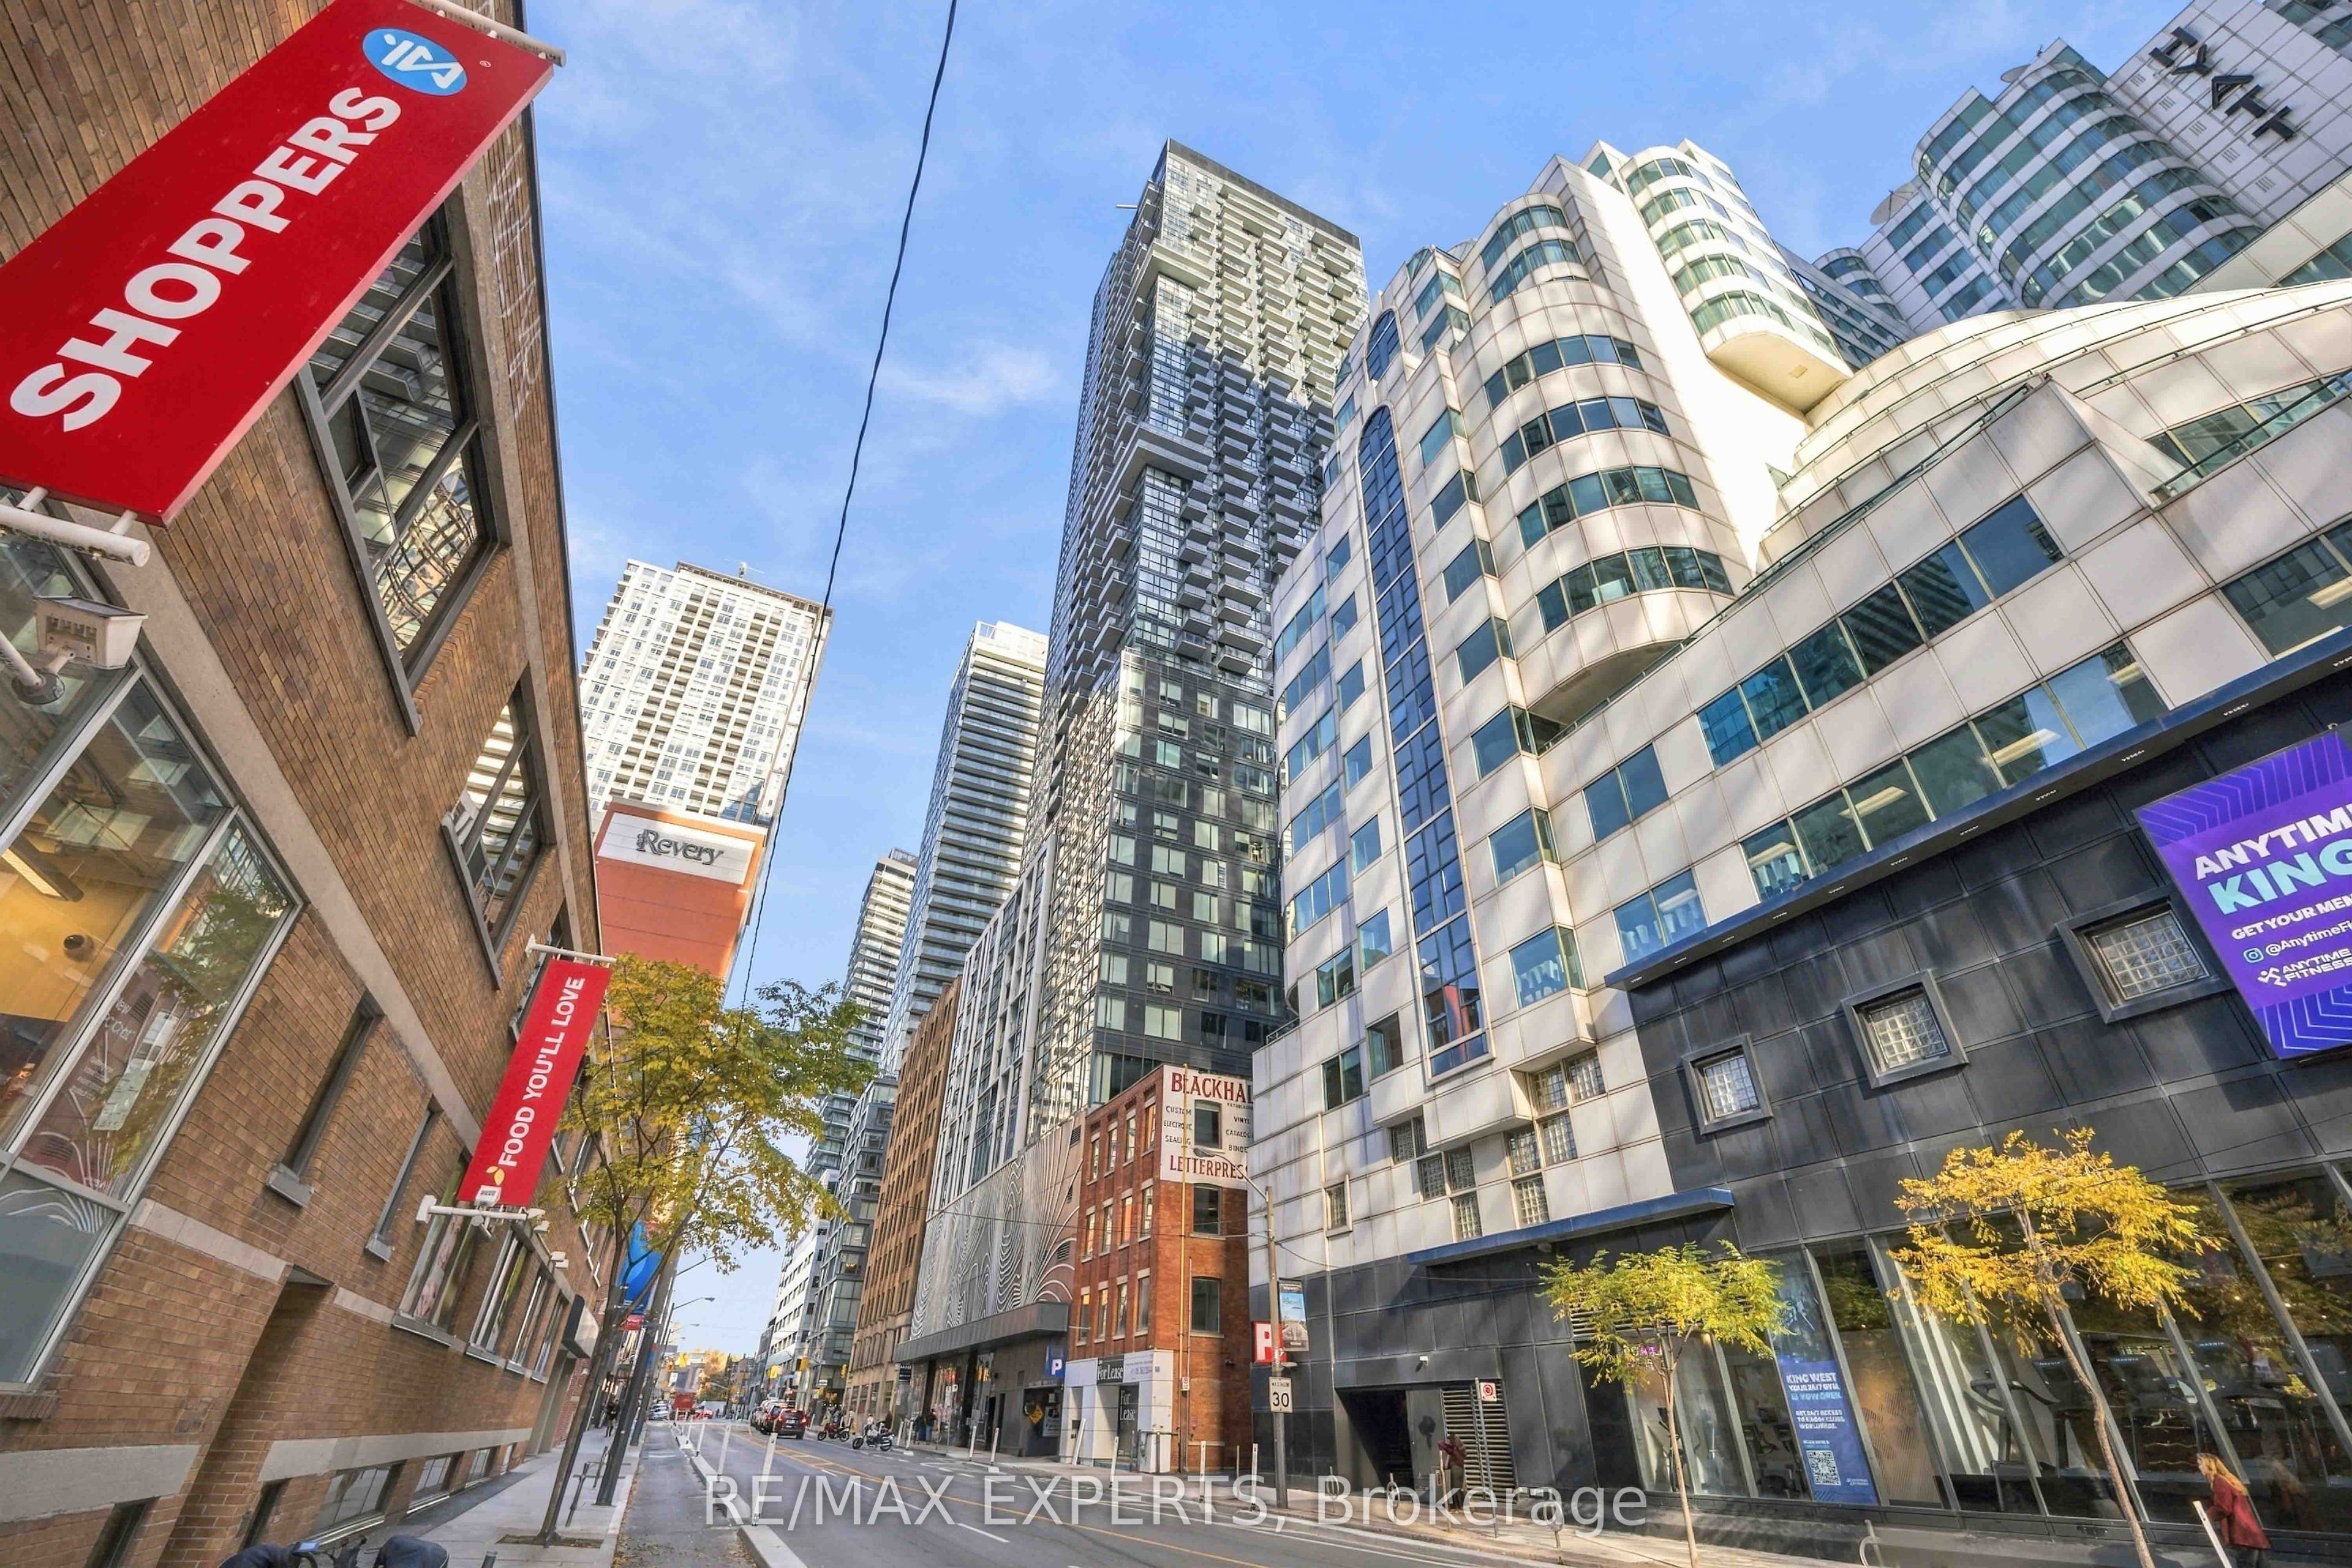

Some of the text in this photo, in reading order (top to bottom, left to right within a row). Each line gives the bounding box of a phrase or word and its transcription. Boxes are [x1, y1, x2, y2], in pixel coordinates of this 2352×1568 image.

[2149, 26, 2298, 142] HYATT
[10, 86, 401, 432] SHOPPERS
[636, 829, 724, 865] Revery
[2196, 802, 2352, 881] ANYTIM
[2207, 838, 2352, 915] KING
[2231, 921, 2265, 940] GET
[2264, 907, 2318, 930] YOUR
[2282, 948, 2352, 974] ANYTIME
[2285, 956, 2352, 982] FITNESS
[498, 976, 585, 1167] FOOD YOU'LL LOVE
[1170, 1155, 1248, 1179] LETTERPRES
[1051, 1359, 1062, 1375] P
[1098, 1365, 1107, 1381] For
[1107, 1364, 1123, 1379] Lease
[1786, 1372, 1836, 1384] KING WEST
[1120, 1390, 1131, 1405] For
[1272, 1391, 1289, 1408] 30
[1120, 1405, 1136, 1420] Lease
